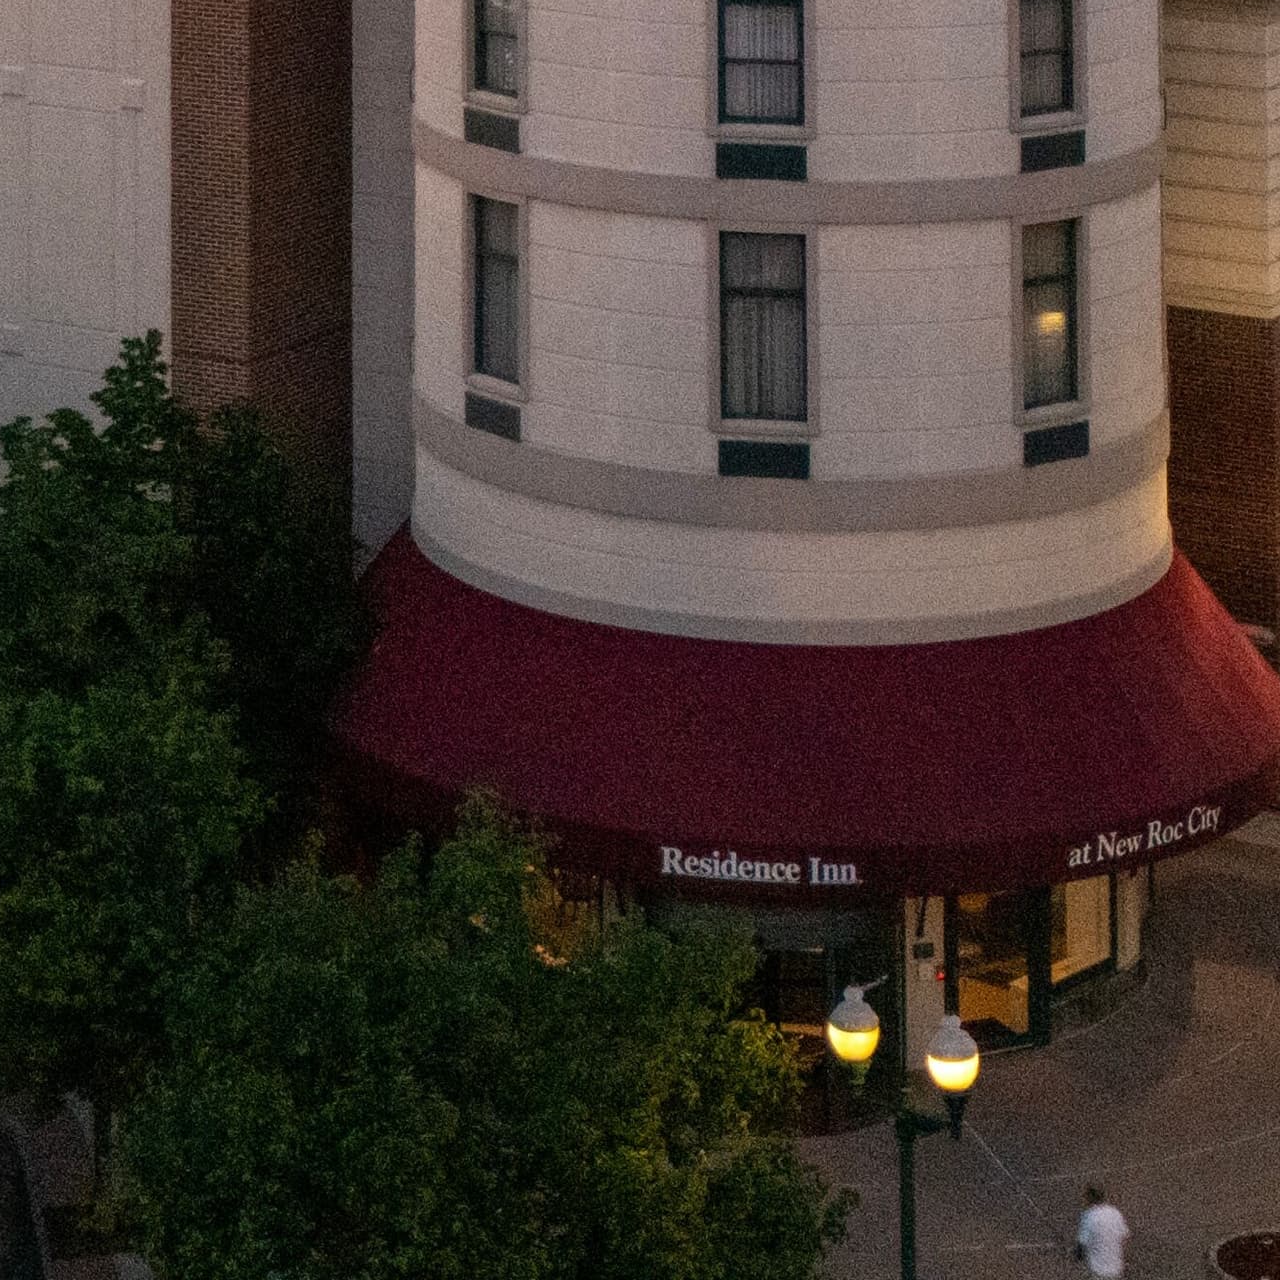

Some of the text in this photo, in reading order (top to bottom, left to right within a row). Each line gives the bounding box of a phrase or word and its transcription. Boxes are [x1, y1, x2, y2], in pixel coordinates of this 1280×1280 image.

[1069, 805, 1221, 867] at New Roc City
[661, 845, 857, 883] Residence Inn
